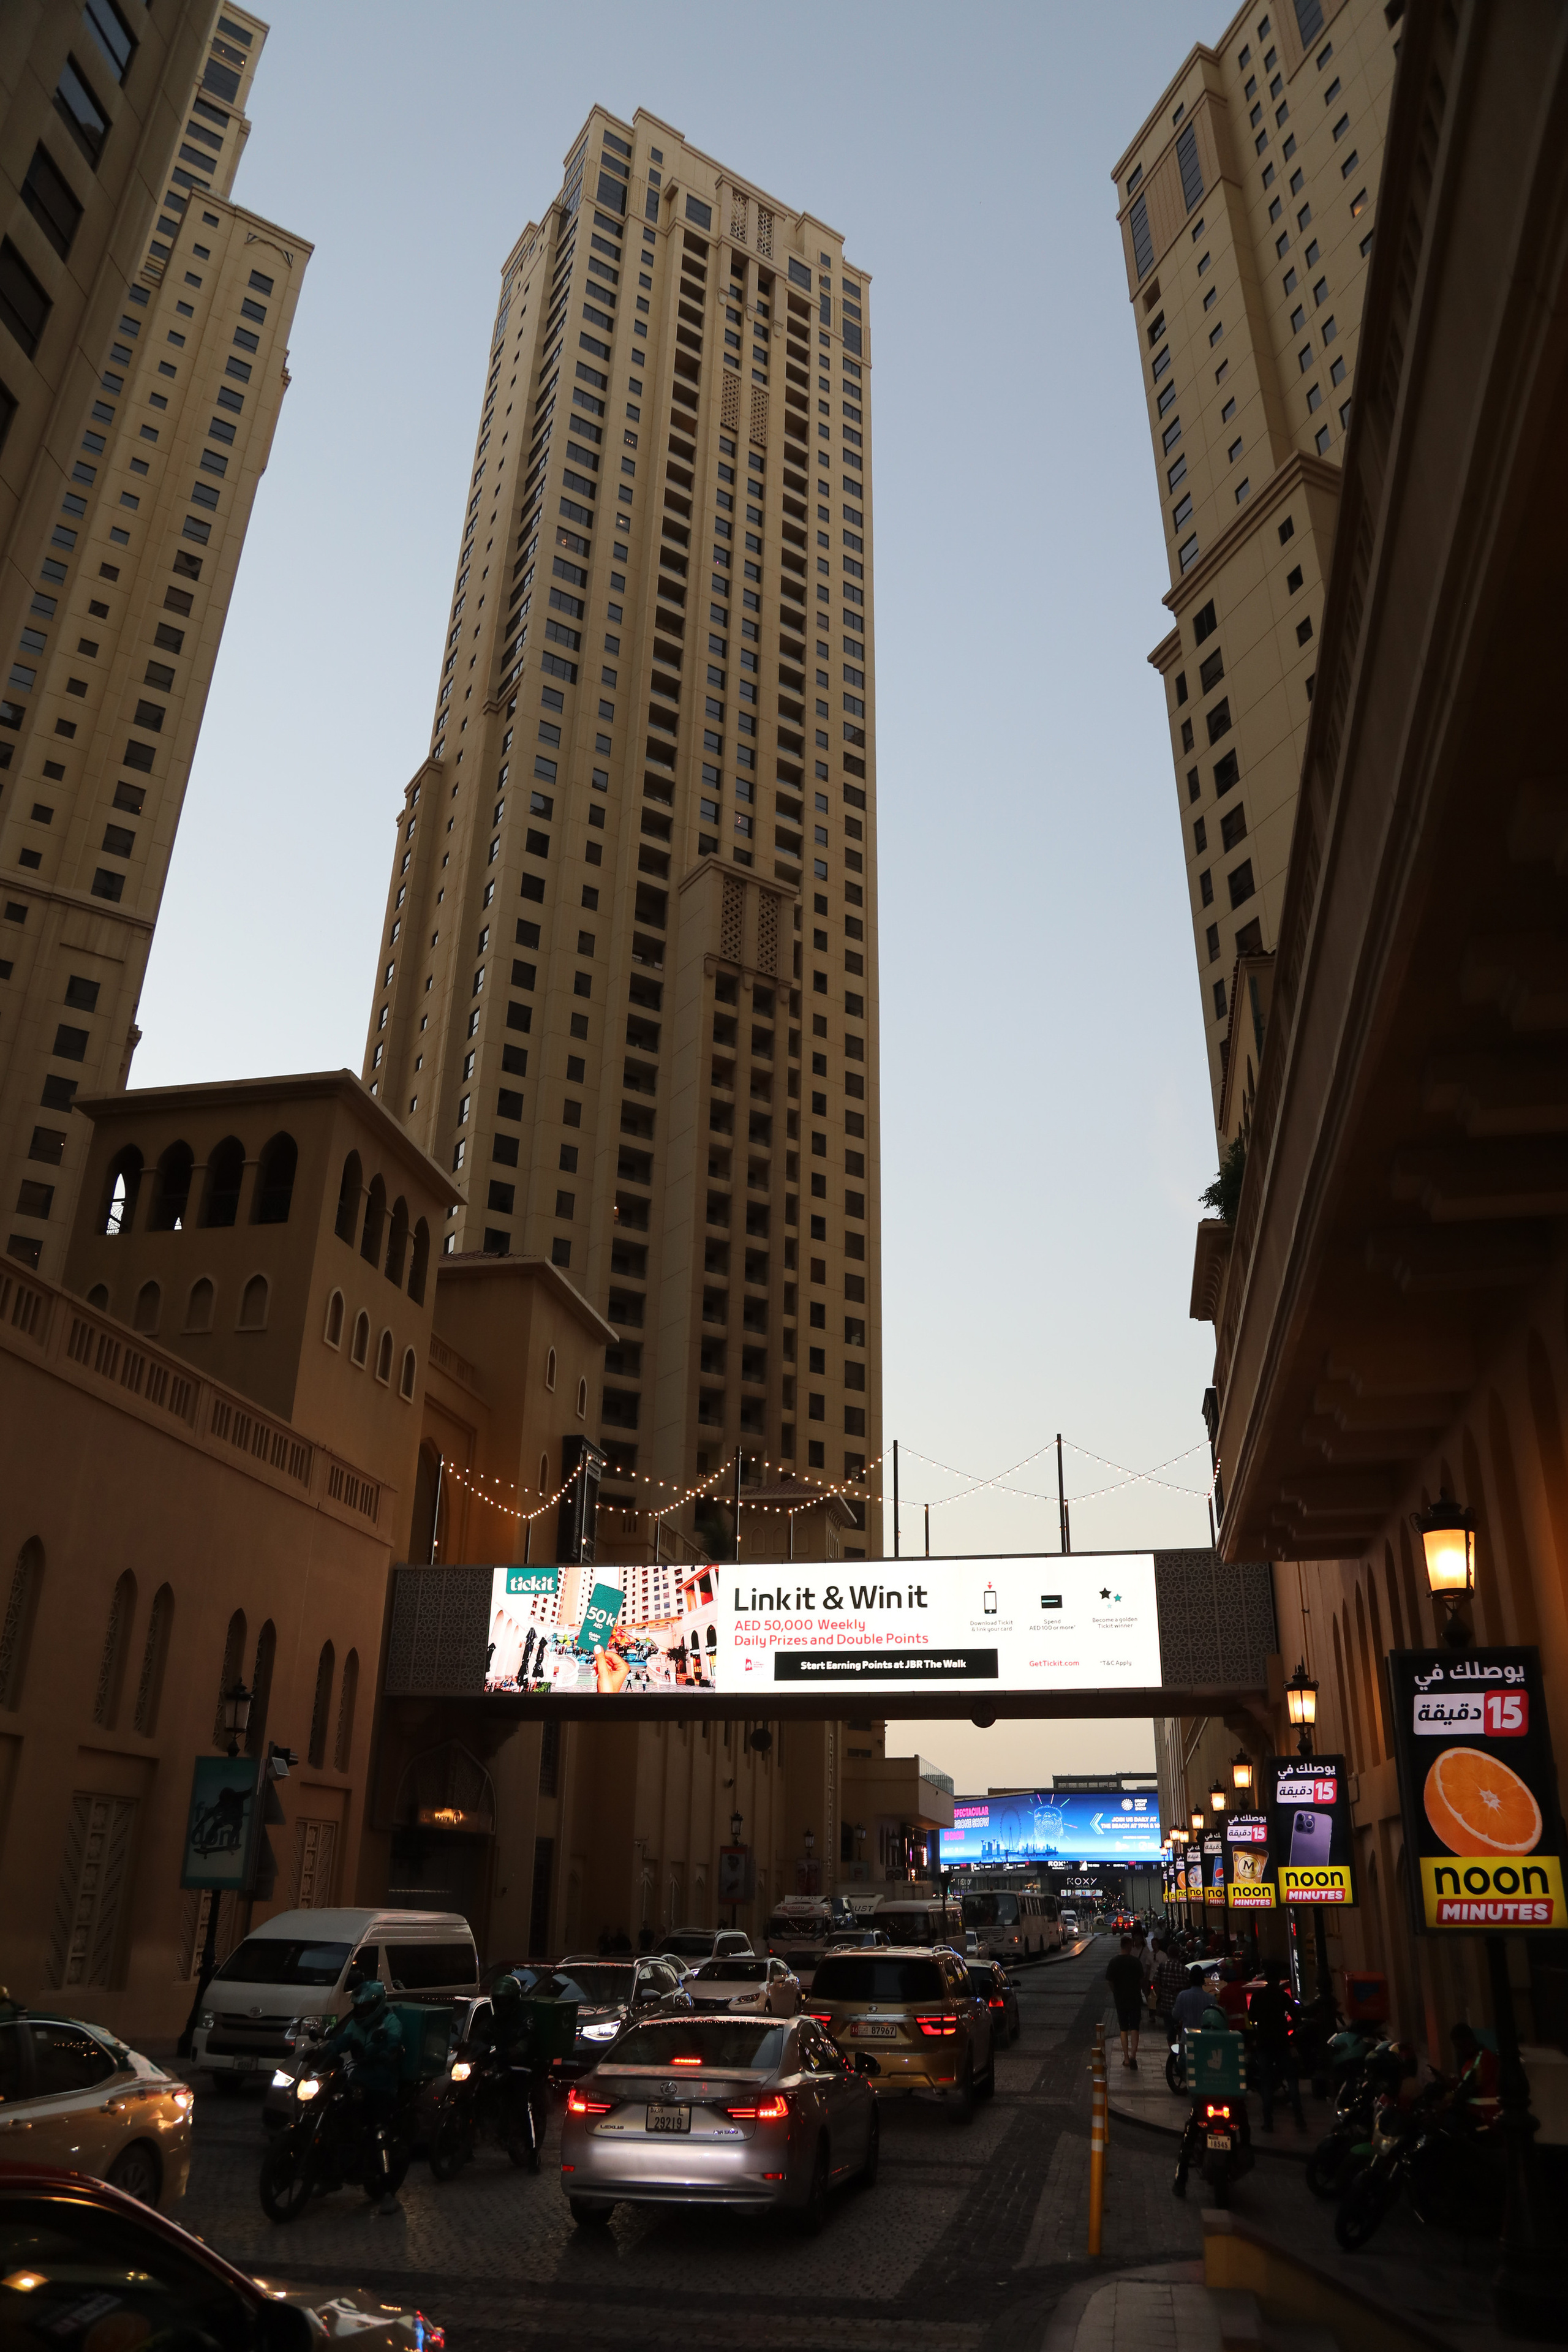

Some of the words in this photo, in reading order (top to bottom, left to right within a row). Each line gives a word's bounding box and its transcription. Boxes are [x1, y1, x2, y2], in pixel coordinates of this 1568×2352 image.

[510, 1575, 554, 1591] tickit
[823, 1586, 844, 1610] &
[734, 1620, 761, 1631] AED
[764, 1619, 813, 1632] 50,000
[818, 1619, 865, 1632] Weekly
[734, 1635, 766, 1648] Daily
[769, 1635, 807, 1645] Prizes
[810, 1634, 833, 1645] and
[837, 1634, 883, 1645] Double
[886, 1633, 929, 1644] Points
[801, 1661, 826, 1670] Start
[826, 1660, 861, 1672] Earning
[862, 1660, 893, 1670] Points
[894, 1660, 905, 1669] at
[905, 1660, 923, 1669] JBR
[924, 1659, 943, 1668] The
[943, 1659, 967, 1668] Walk
[1414, 1664, 1444, 1691] في
[1450, 1661, 1525, 1684] يوصلك
[1418, 1703, 1482, 1725] دقيقة
[1487, 1696, 1523, 1729] 15
[1278, 1765, 1294, 1779] في
[1296, 1763, 1336, 1776] يوصلك
[1280, 1786, 1313, 1798] دقيقة
[1316, 1782, 1334, 1800] 15
[972, 1817, 990, 1828] SHOW
[1228, 1815, 1238, 1825] في
[1240, 1814, 1267, 1823] يوصلك
[1204, 1833, 1213, 1841] في
[1253, 1827, 1265, 1839] 15
[1243, 1860, 1254, 1871] M
[1286, 1872, 1344, 1887] noon
[1434, 1866, 1550, 1895] noon
[1233, 1887, 1271, 1896] noon
[1289, 1891, 1343, 1900] MINUTES
[1442, 1903, 1548, 1920] MINUTES
[679, 2108, 684, 2116] L
[655, 2117, 682, 2129] 29219
